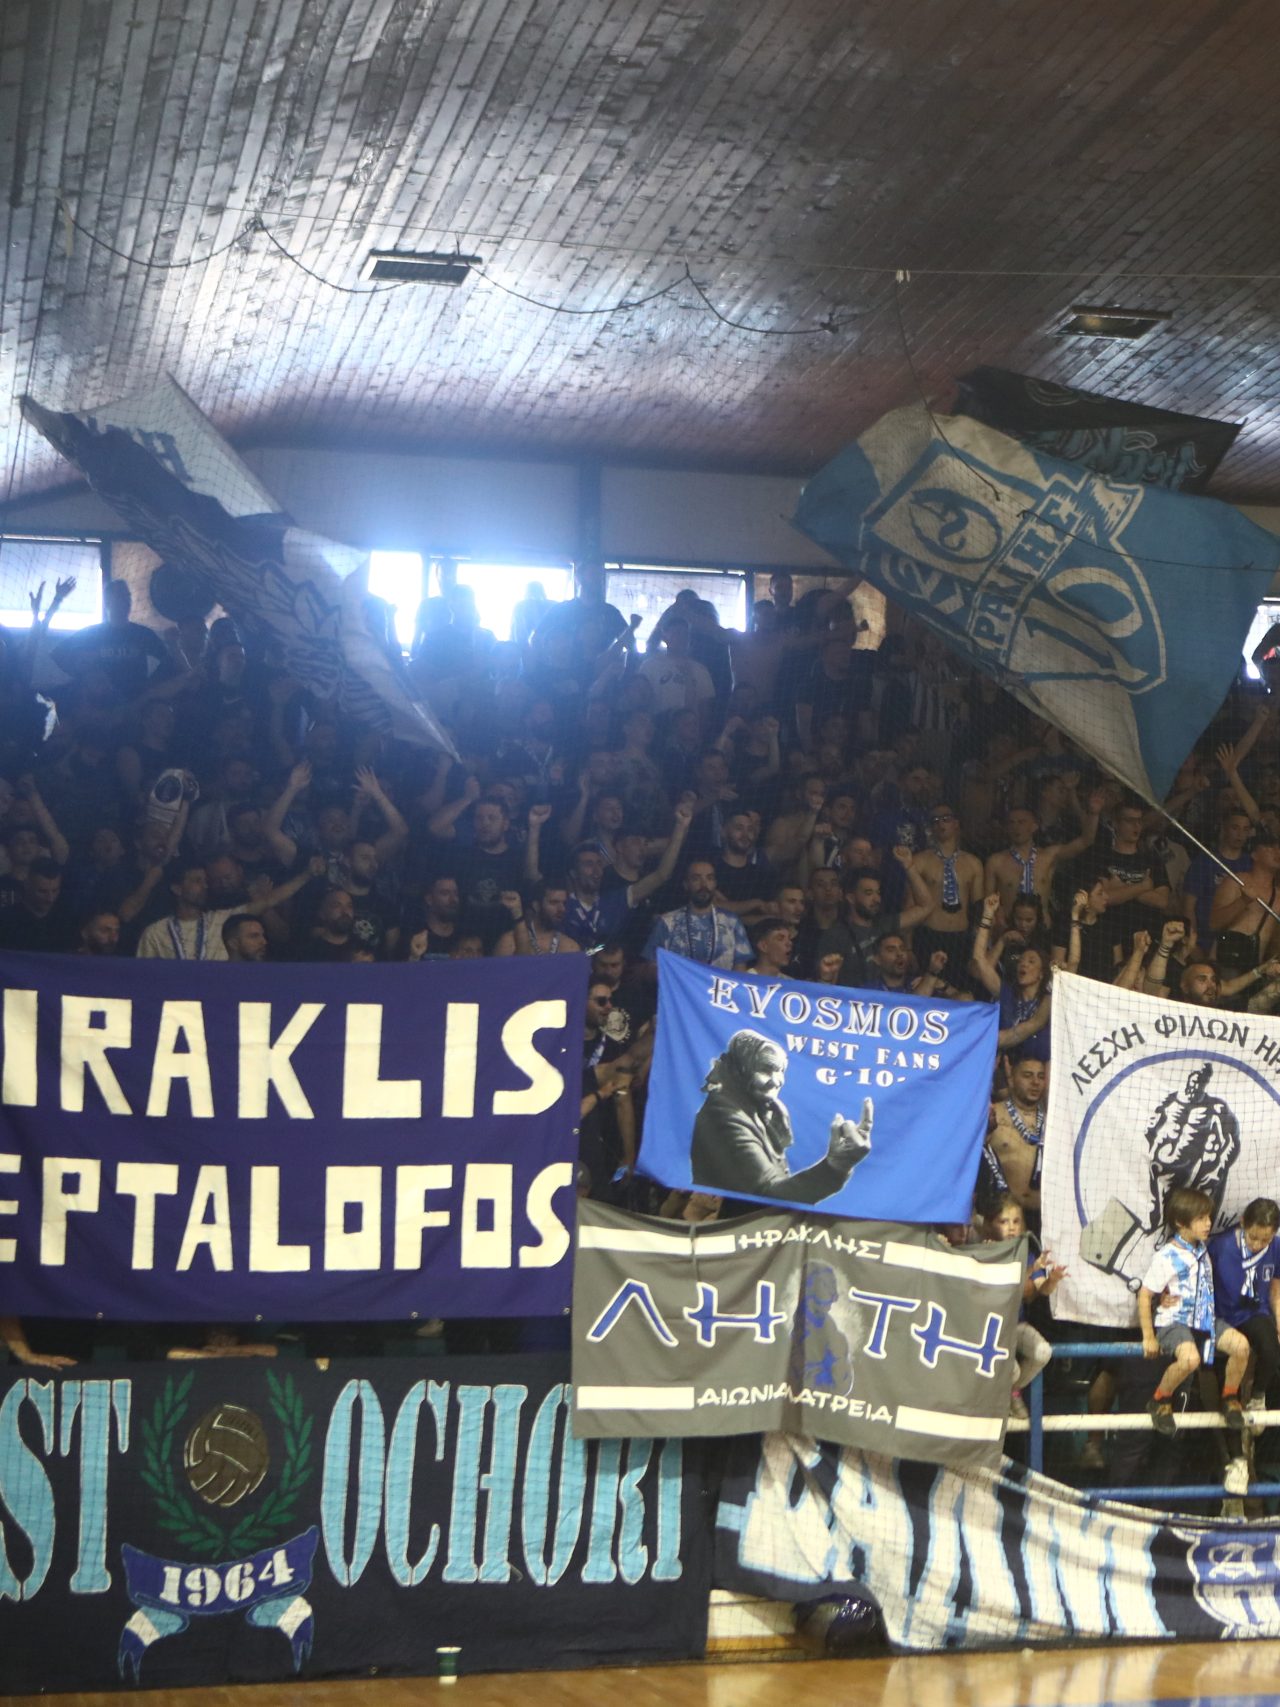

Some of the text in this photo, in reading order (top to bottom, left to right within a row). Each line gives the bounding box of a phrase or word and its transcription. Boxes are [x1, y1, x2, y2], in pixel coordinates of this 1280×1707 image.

[708, 974, 951, 1045] EVOSMOS
[2, 988, 568, 1119] IRAKLIS
[785, 1033, 942, 1071] WEST FANS
[1070, 1022, 1146, 1096] ΛΕΣΧΗ
[1154, 1014, 1250, 1049] ΦΙΛΩΝ
[738, 1225, 885, 1261] ΗΡΑΚΛΗΣ
[157, 1546, 296, 1608] 1964
